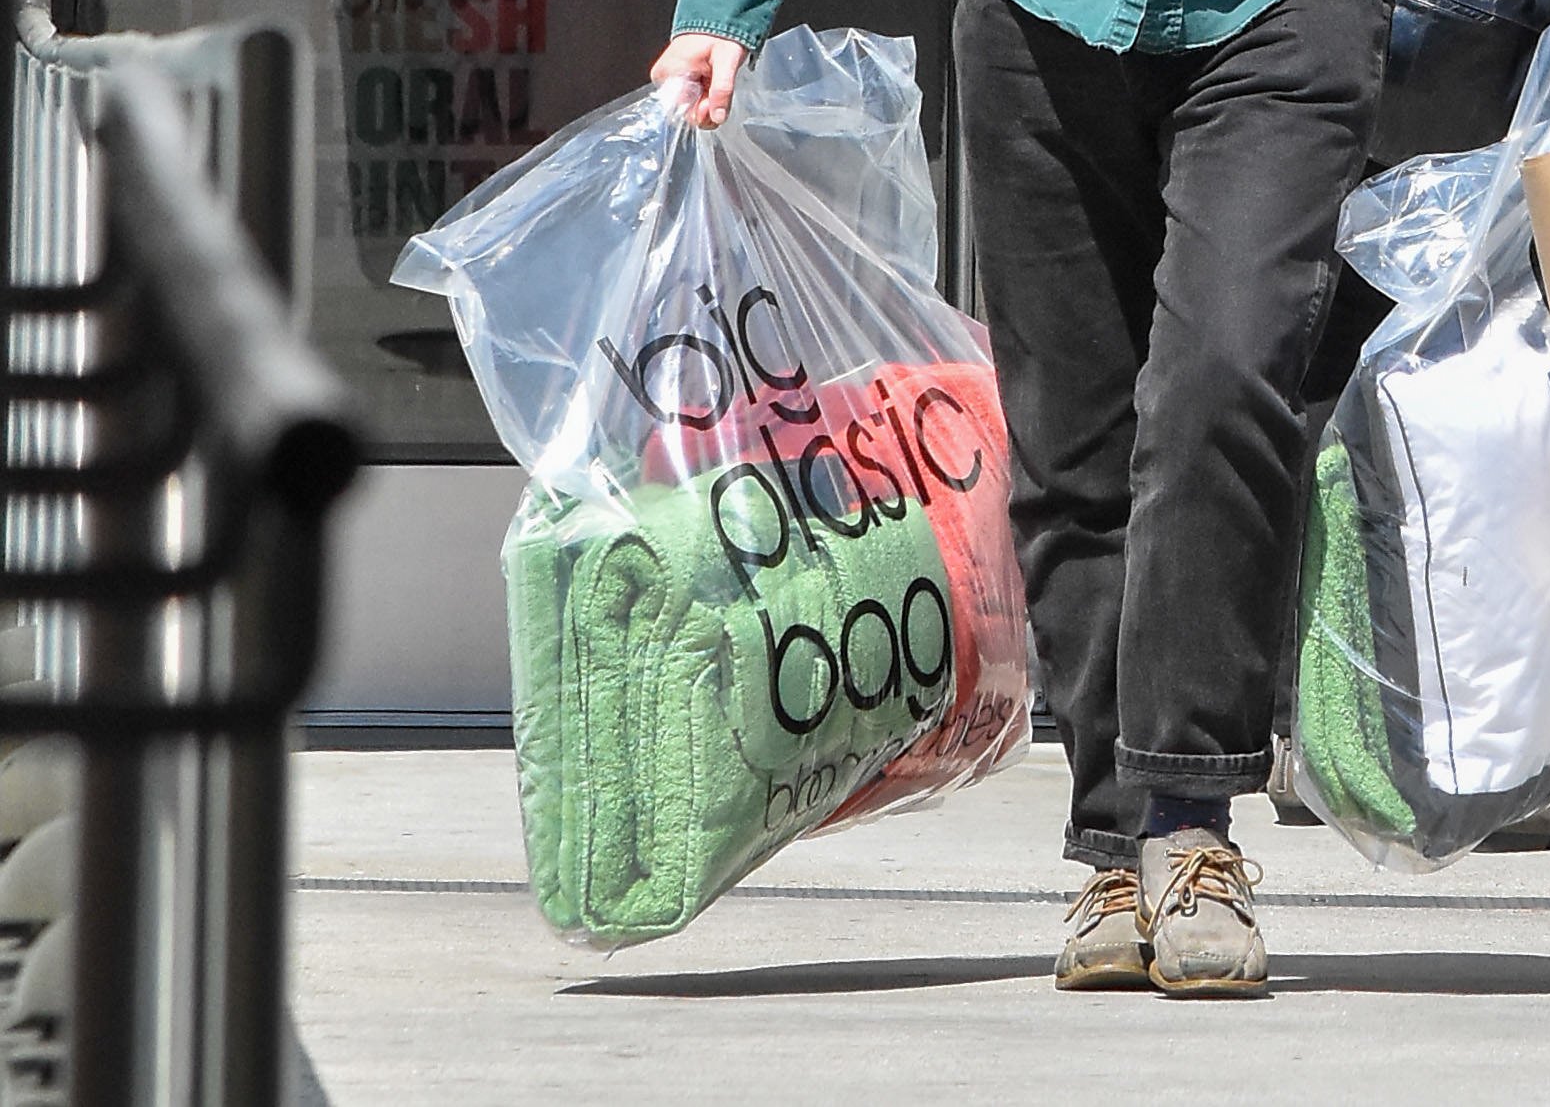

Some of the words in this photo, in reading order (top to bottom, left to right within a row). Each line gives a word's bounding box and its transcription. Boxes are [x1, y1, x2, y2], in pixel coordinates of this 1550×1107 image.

[597, 284, 822, 432] big
[711, 379, 982, 603] plasic
[756, 577, 950, 734] bag
